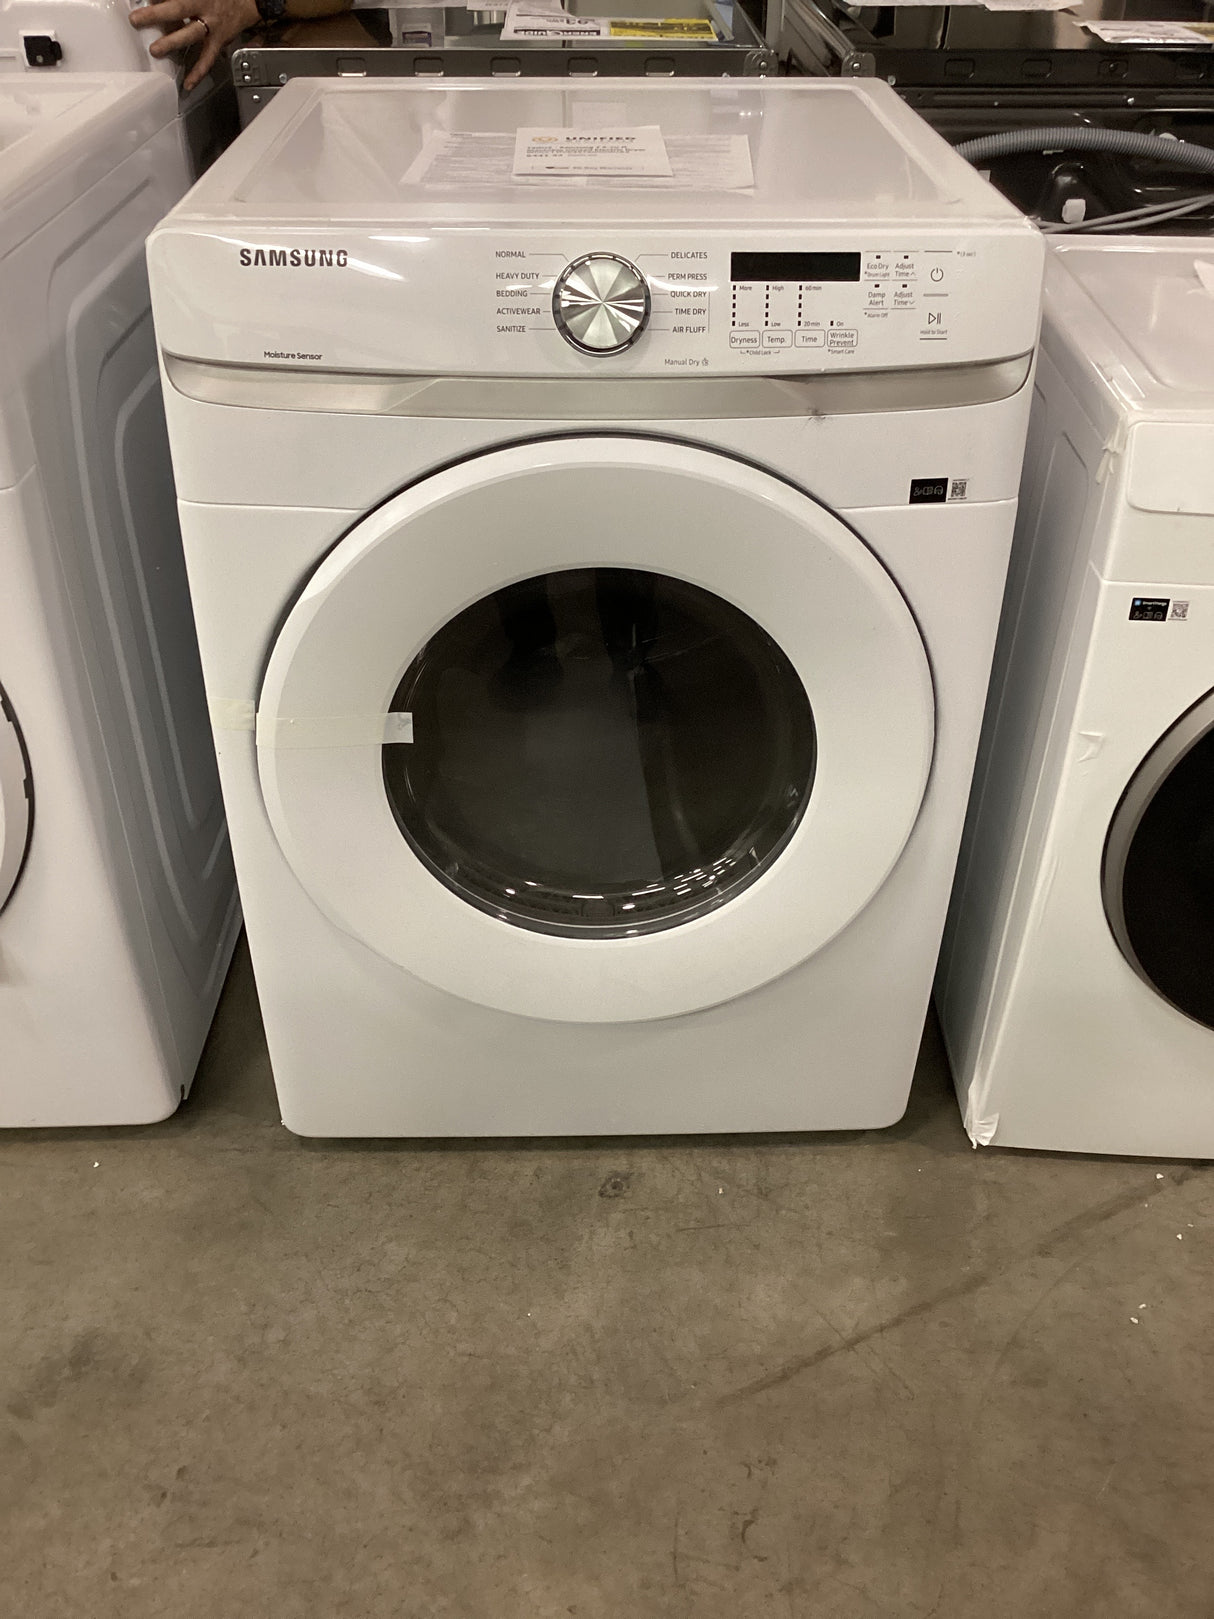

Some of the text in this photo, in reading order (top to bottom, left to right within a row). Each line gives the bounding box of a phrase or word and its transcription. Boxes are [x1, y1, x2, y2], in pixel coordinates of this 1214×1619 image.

[240, 248, 348, 267] SAMSUNG
[878, 263, 889, 271] Dry
[731, 337, 758, 345] Dryness
[264, 351, 323, 360] Moisture Sensor
[688, 359, 700, 367] Dry
